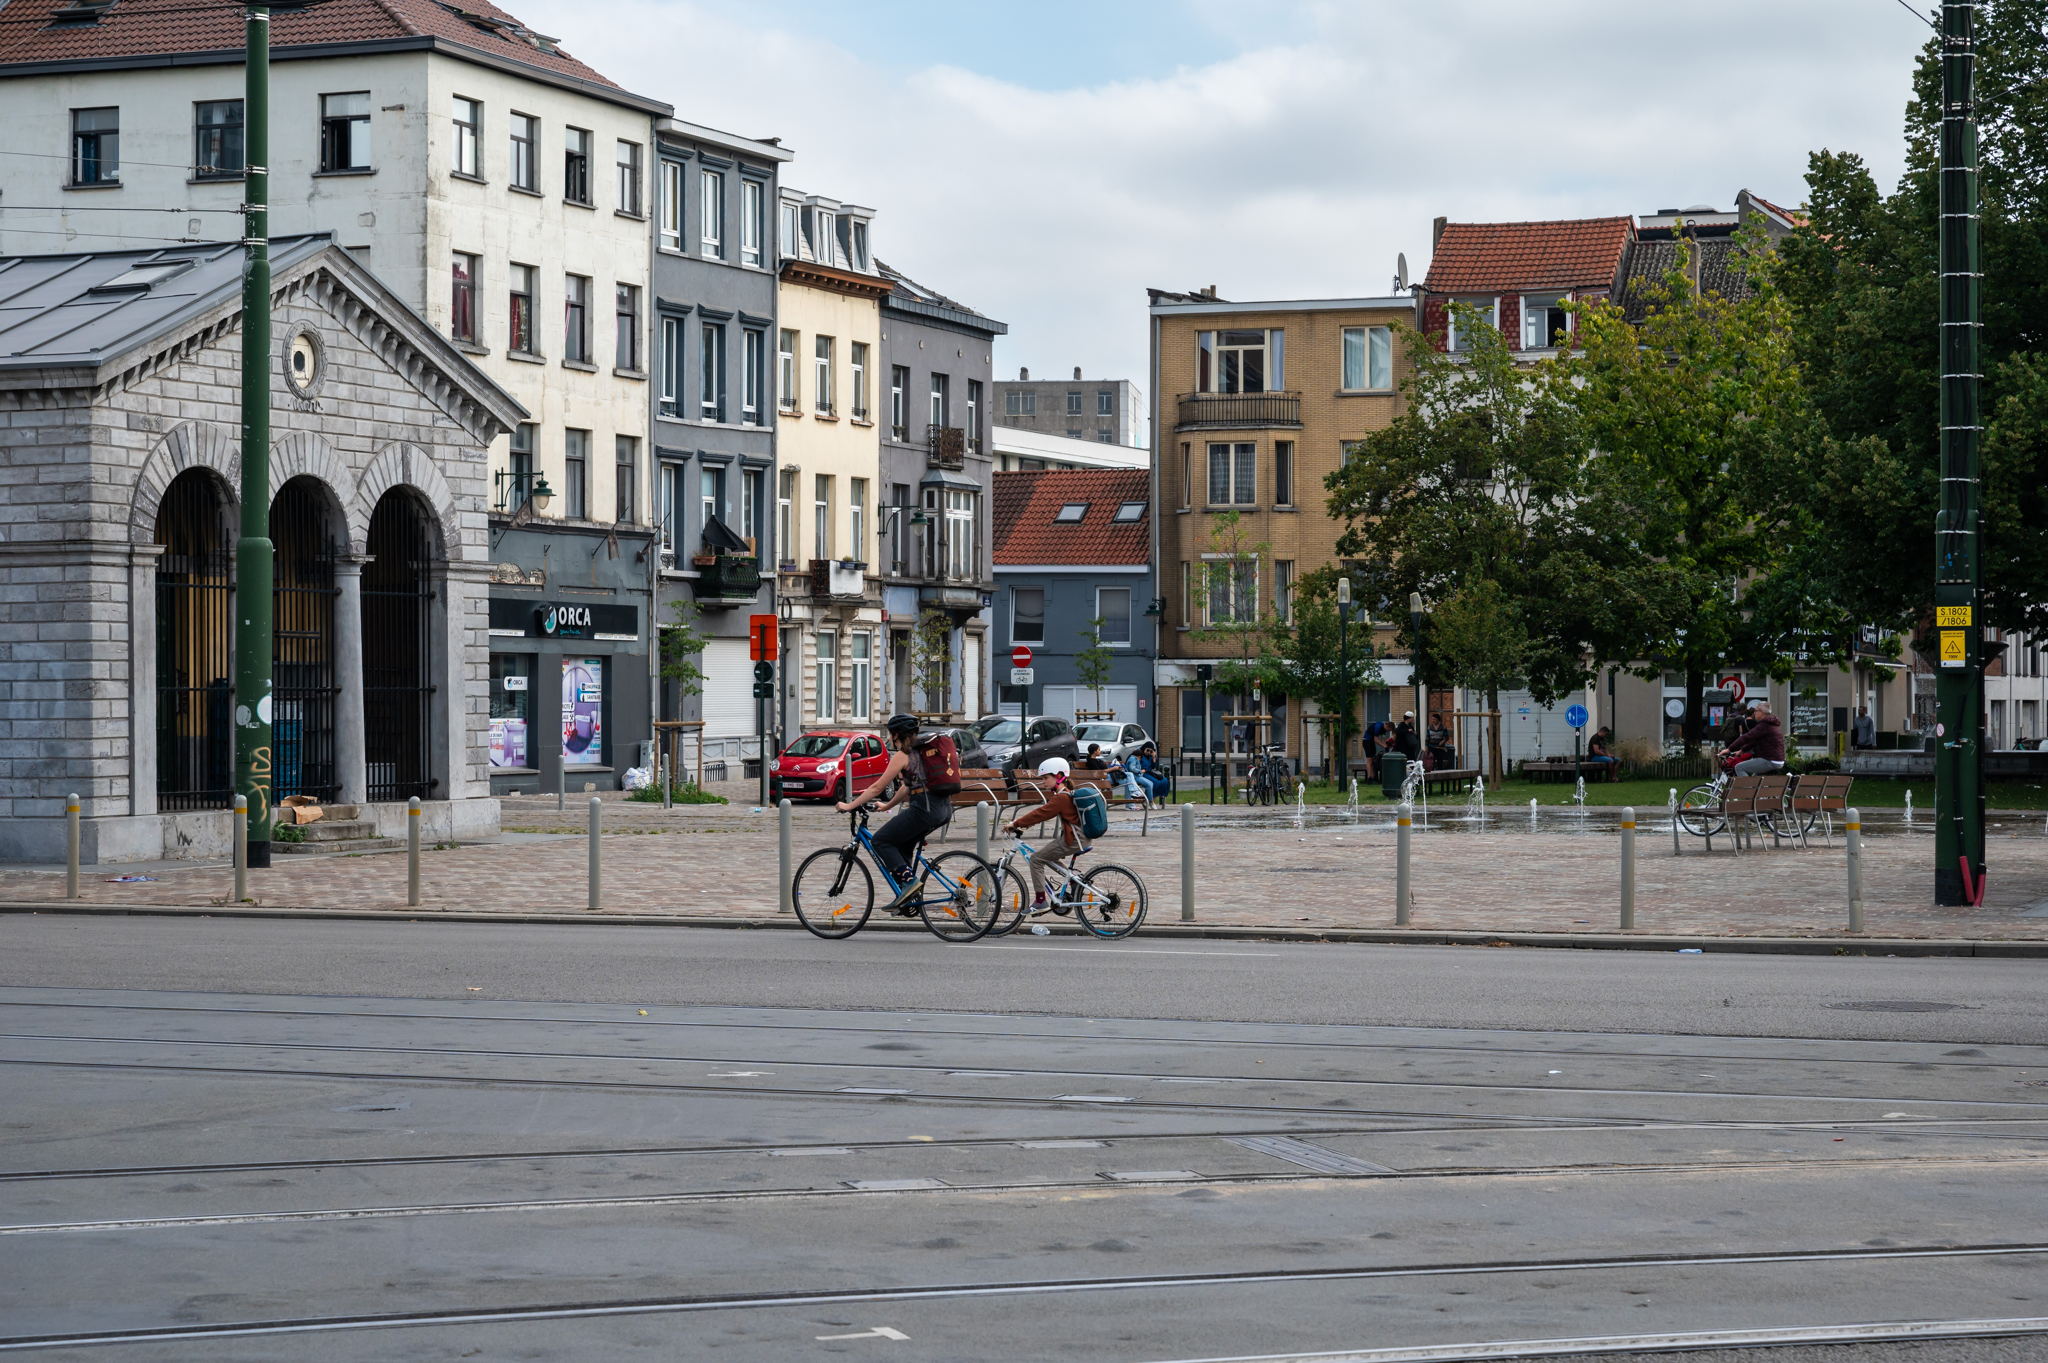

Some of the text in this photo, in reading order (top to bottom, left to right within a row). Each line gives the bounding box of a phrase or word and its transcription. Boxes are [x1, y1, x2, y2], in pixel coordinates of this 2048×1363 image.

[558, 606, 592, 626] ORCA
[1940, 607, 1968, 616] S.1802
[1941, 617, 1967, 625] /1806
